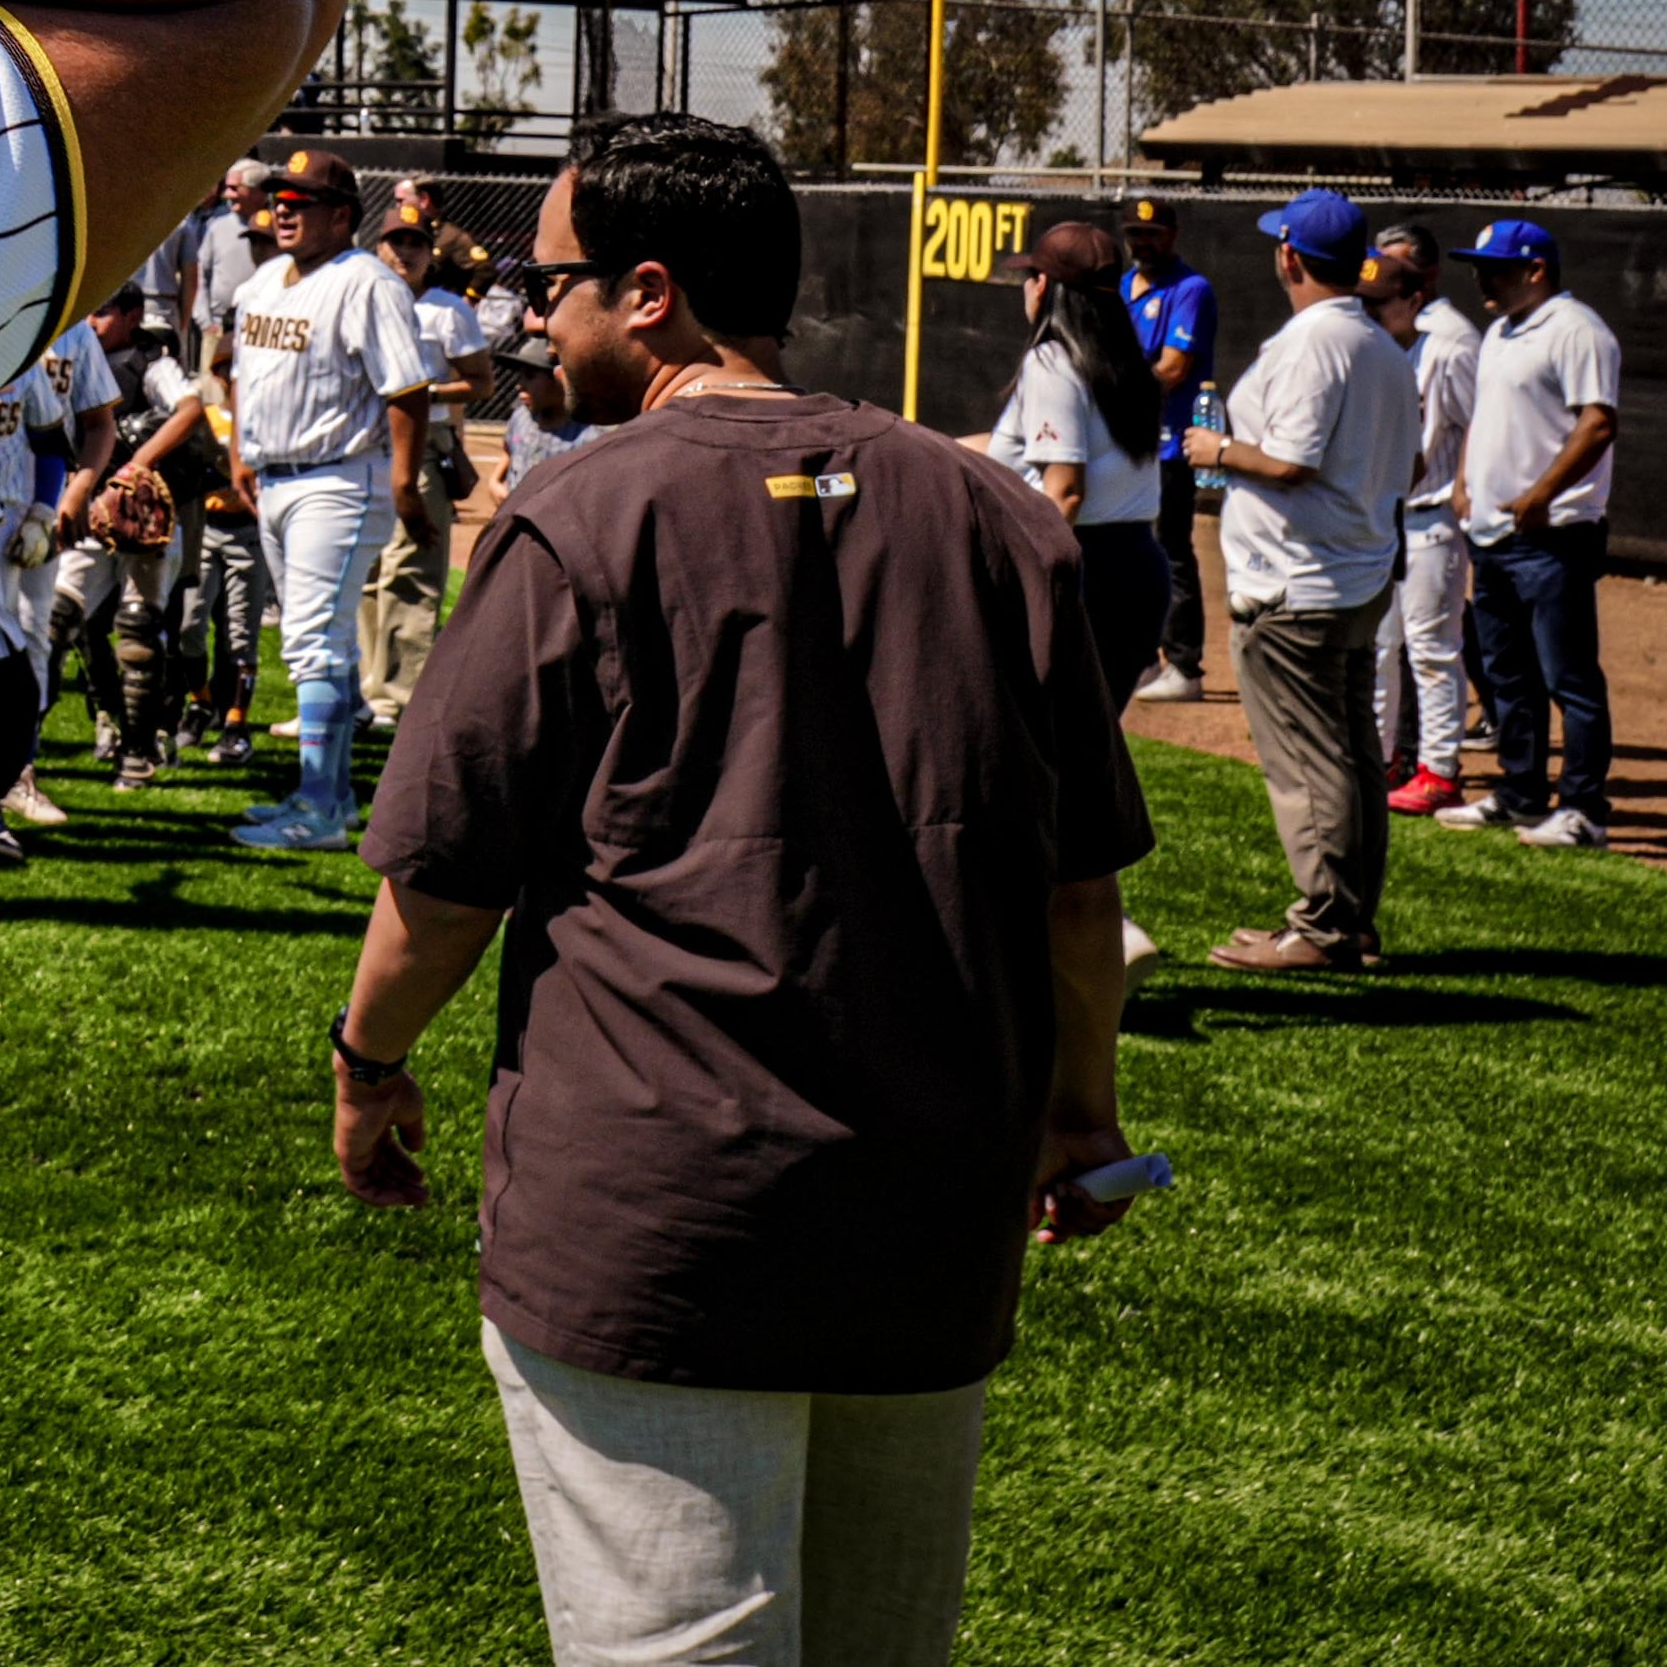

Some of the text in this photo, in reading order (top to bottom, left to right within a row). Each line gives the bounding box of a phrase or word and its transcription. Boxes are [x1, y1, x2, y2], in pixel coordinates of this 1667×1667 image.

[922, 196, 1029, 283] 200 FT
[240, 312, 310, 353] PADRES
